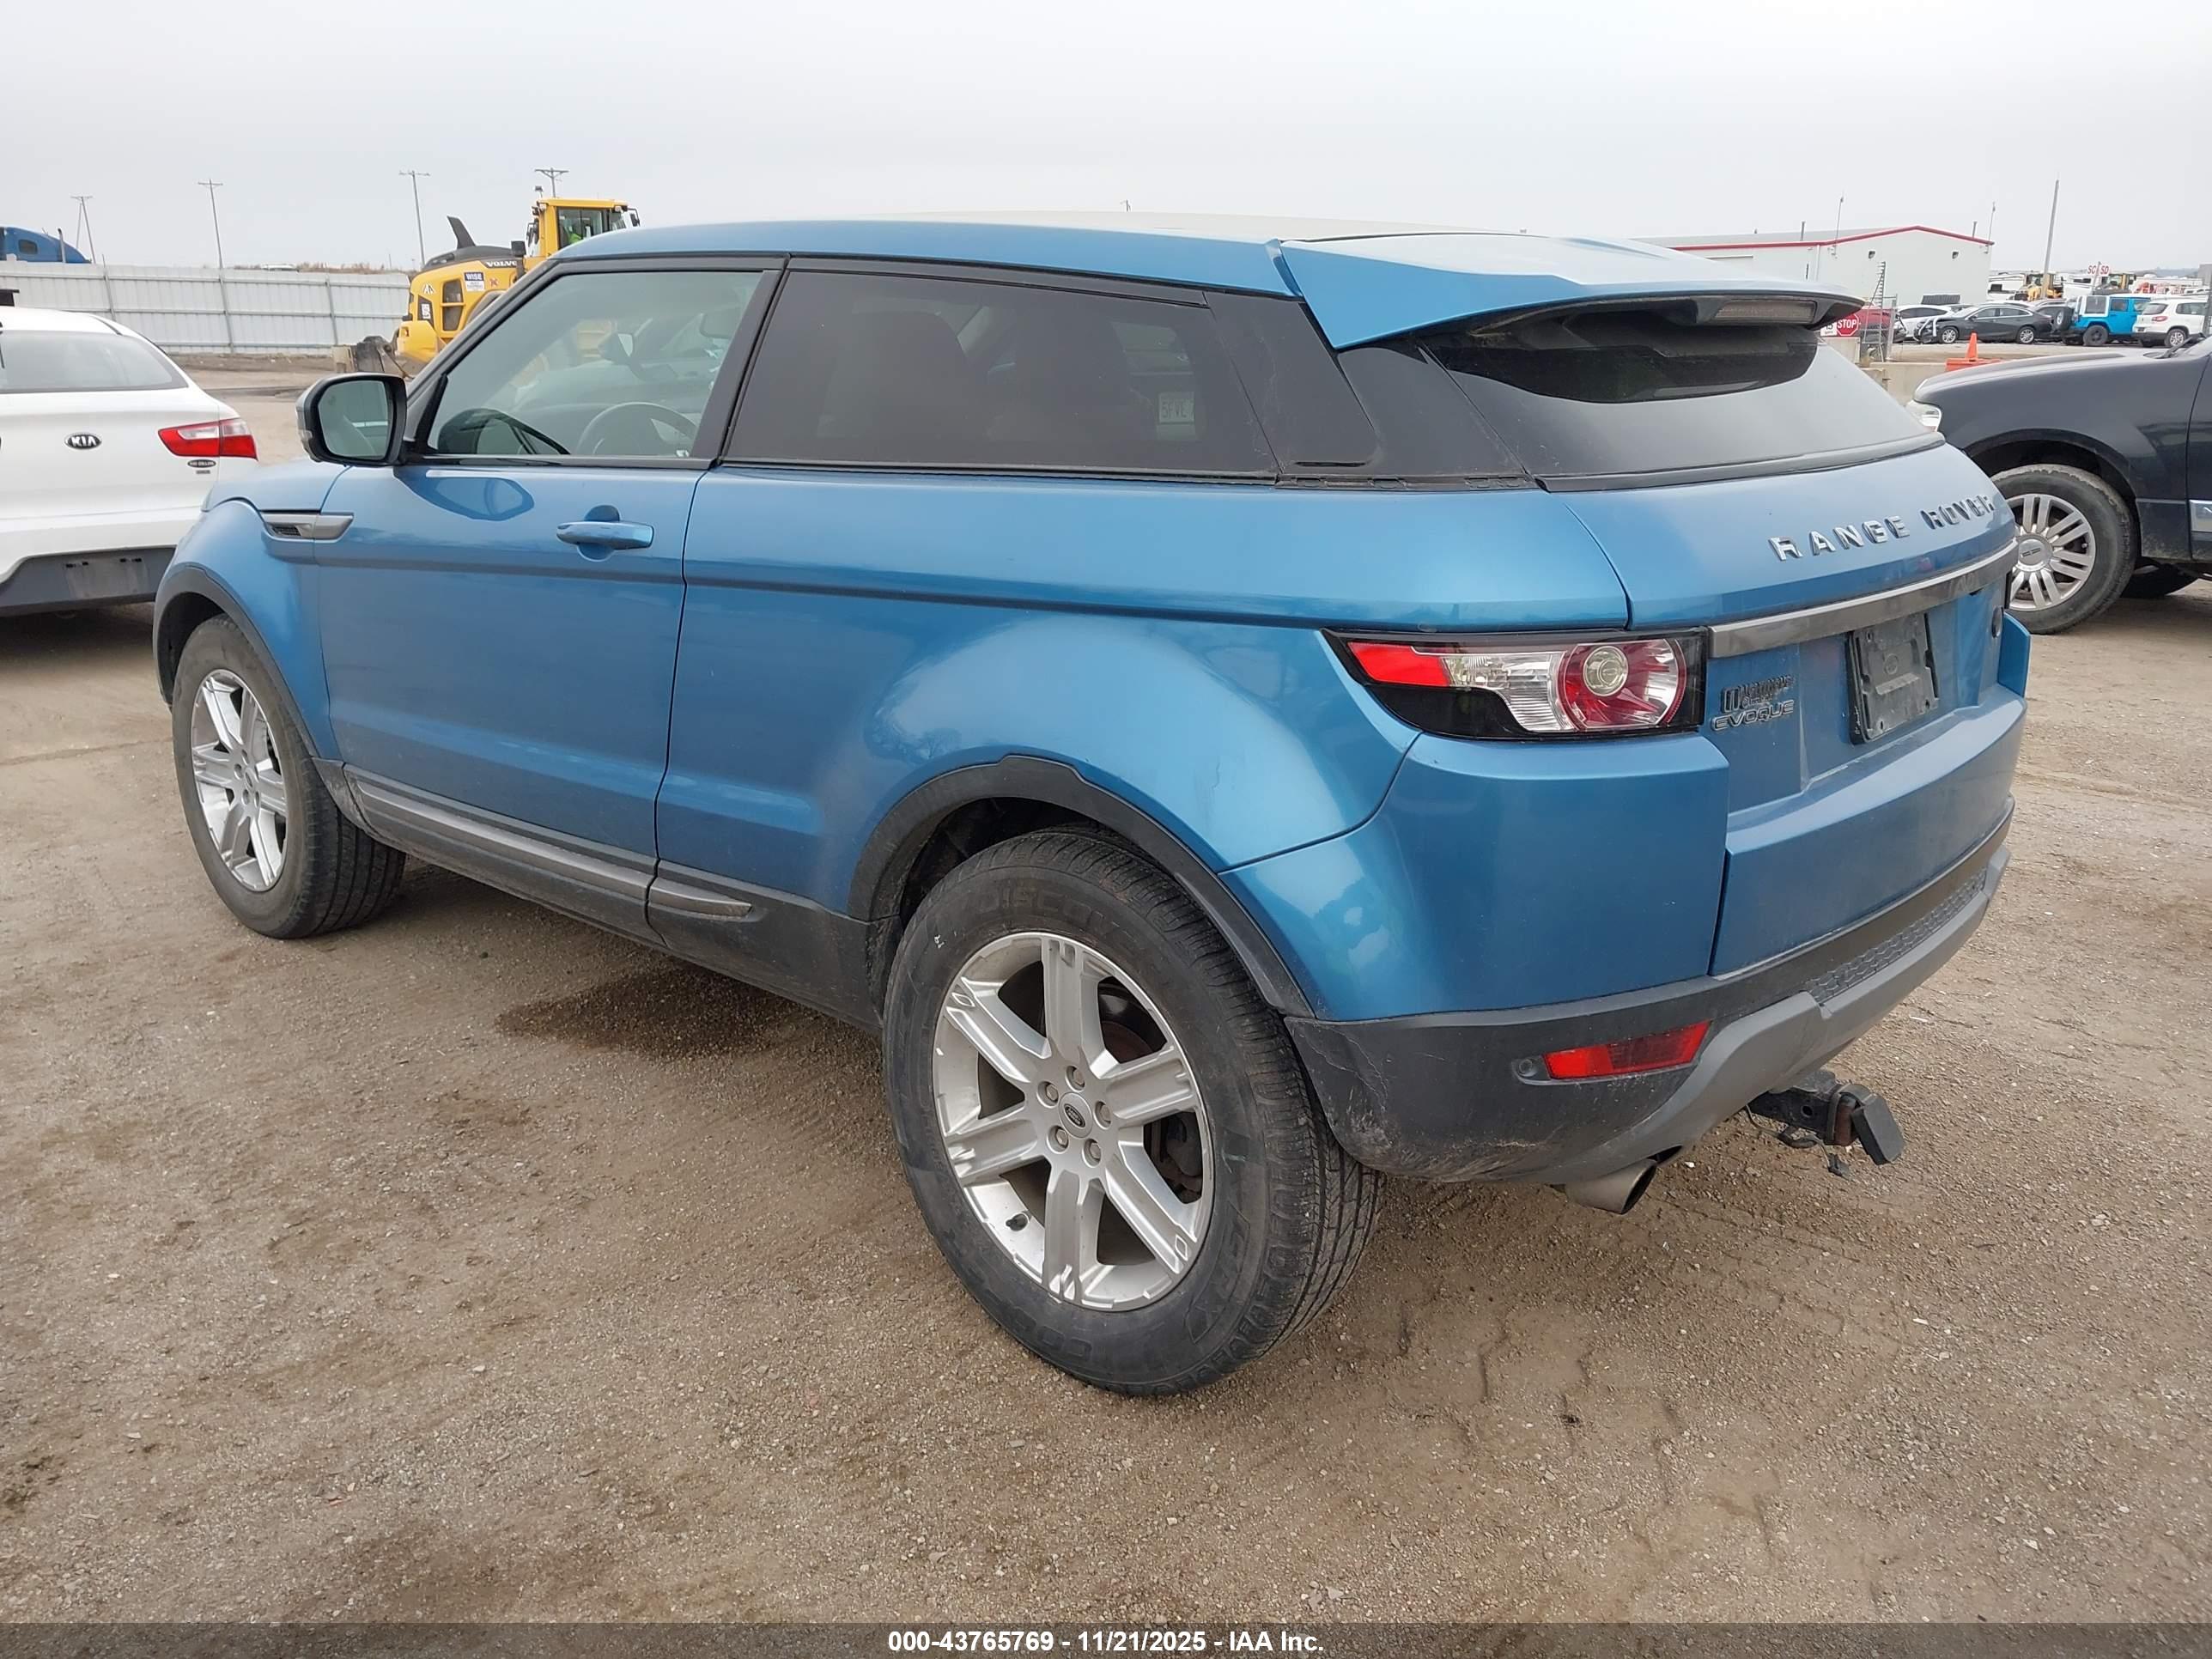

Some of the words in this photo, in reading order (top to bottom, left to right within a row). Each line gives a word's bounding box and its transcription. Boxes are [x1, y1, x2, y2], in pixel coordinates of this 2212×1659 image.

[1838, 319, 1856, 329] STOP
[72, 434, 97, 447] KIA
[1769, 515, 1910, 562] RANGE
[1920, 495, 1996, 530] ROVER
[1711, 700, 1795, 731] EVOQUE
